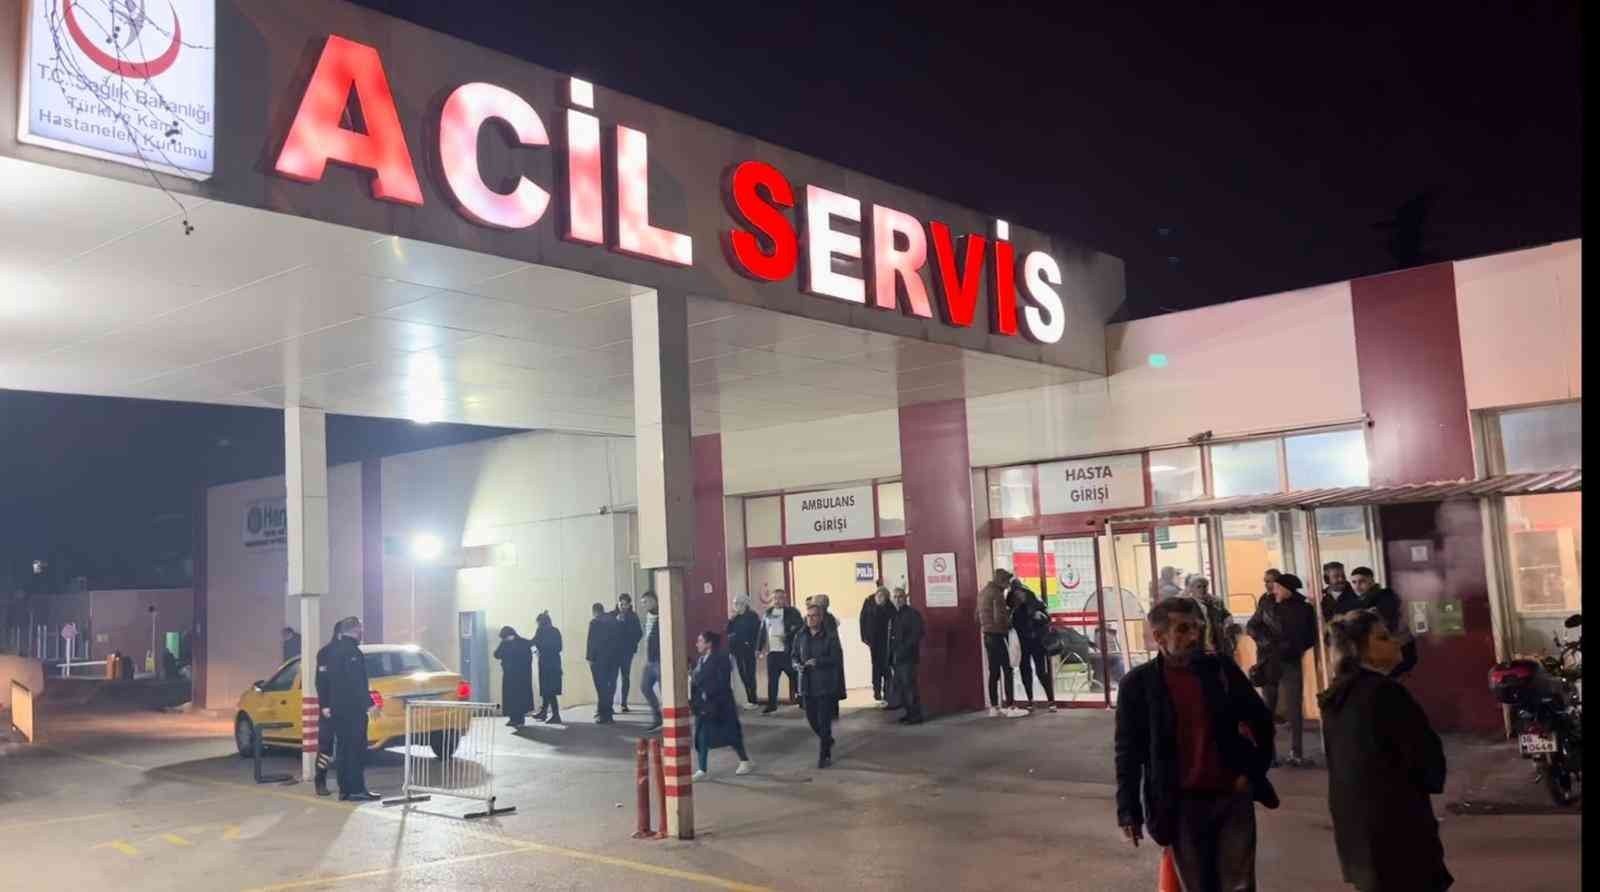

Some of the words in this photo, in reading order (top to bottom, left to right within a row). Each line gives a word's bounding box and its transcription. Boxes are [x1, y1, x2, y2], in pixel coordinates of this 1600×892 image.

[272, 33, 693, 267] ACİL
[725, 160, 1065, 344] SERVİS
[1065, 465, 1112, 481] HASTA
[1070, 483, 1109, 504] GİRİŞİ
[801, 495, 855, 511] AMBULANS
[814, 516, 848, 533] GİRİŞİ
